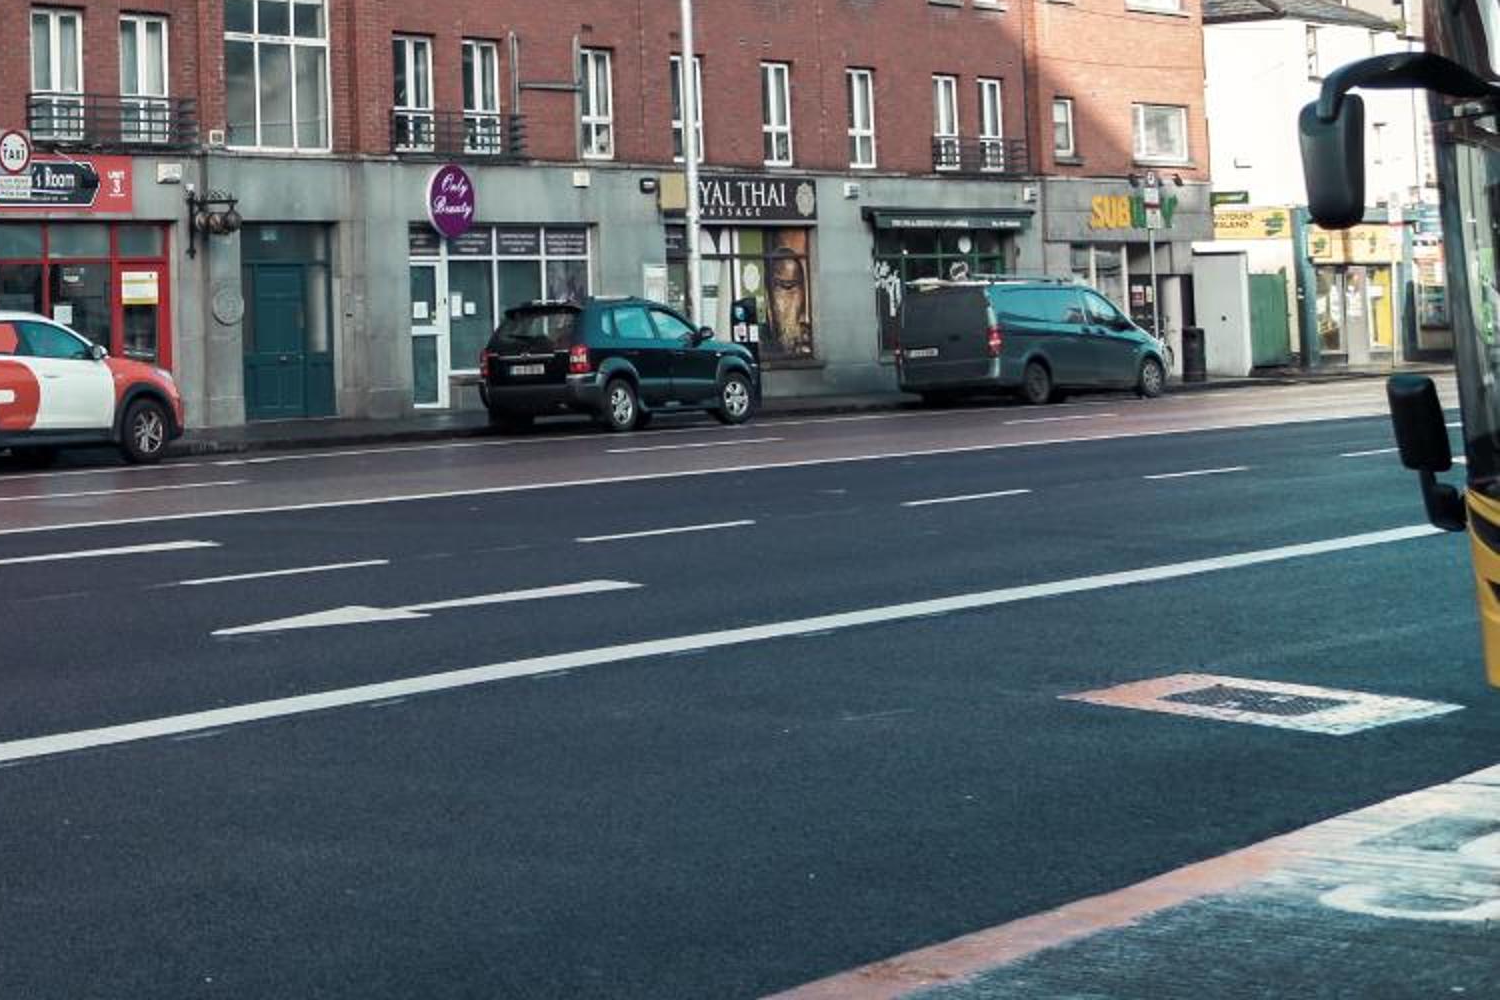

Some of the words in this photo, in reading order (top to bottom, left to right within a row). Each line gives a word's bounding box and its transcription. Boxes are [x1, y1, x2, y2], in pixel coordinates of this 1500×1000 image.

[3, 149, 25, 161] TAXI
[45, 166, 75, 187] Room
[441, 173, 468, 198] Only
[699, 181, 736, 207] YAL
[737, 182, 786, 207] THAI
[434, 196, 472, 219] Beauty
[1090, 193, 1178, 229] SUBWY
